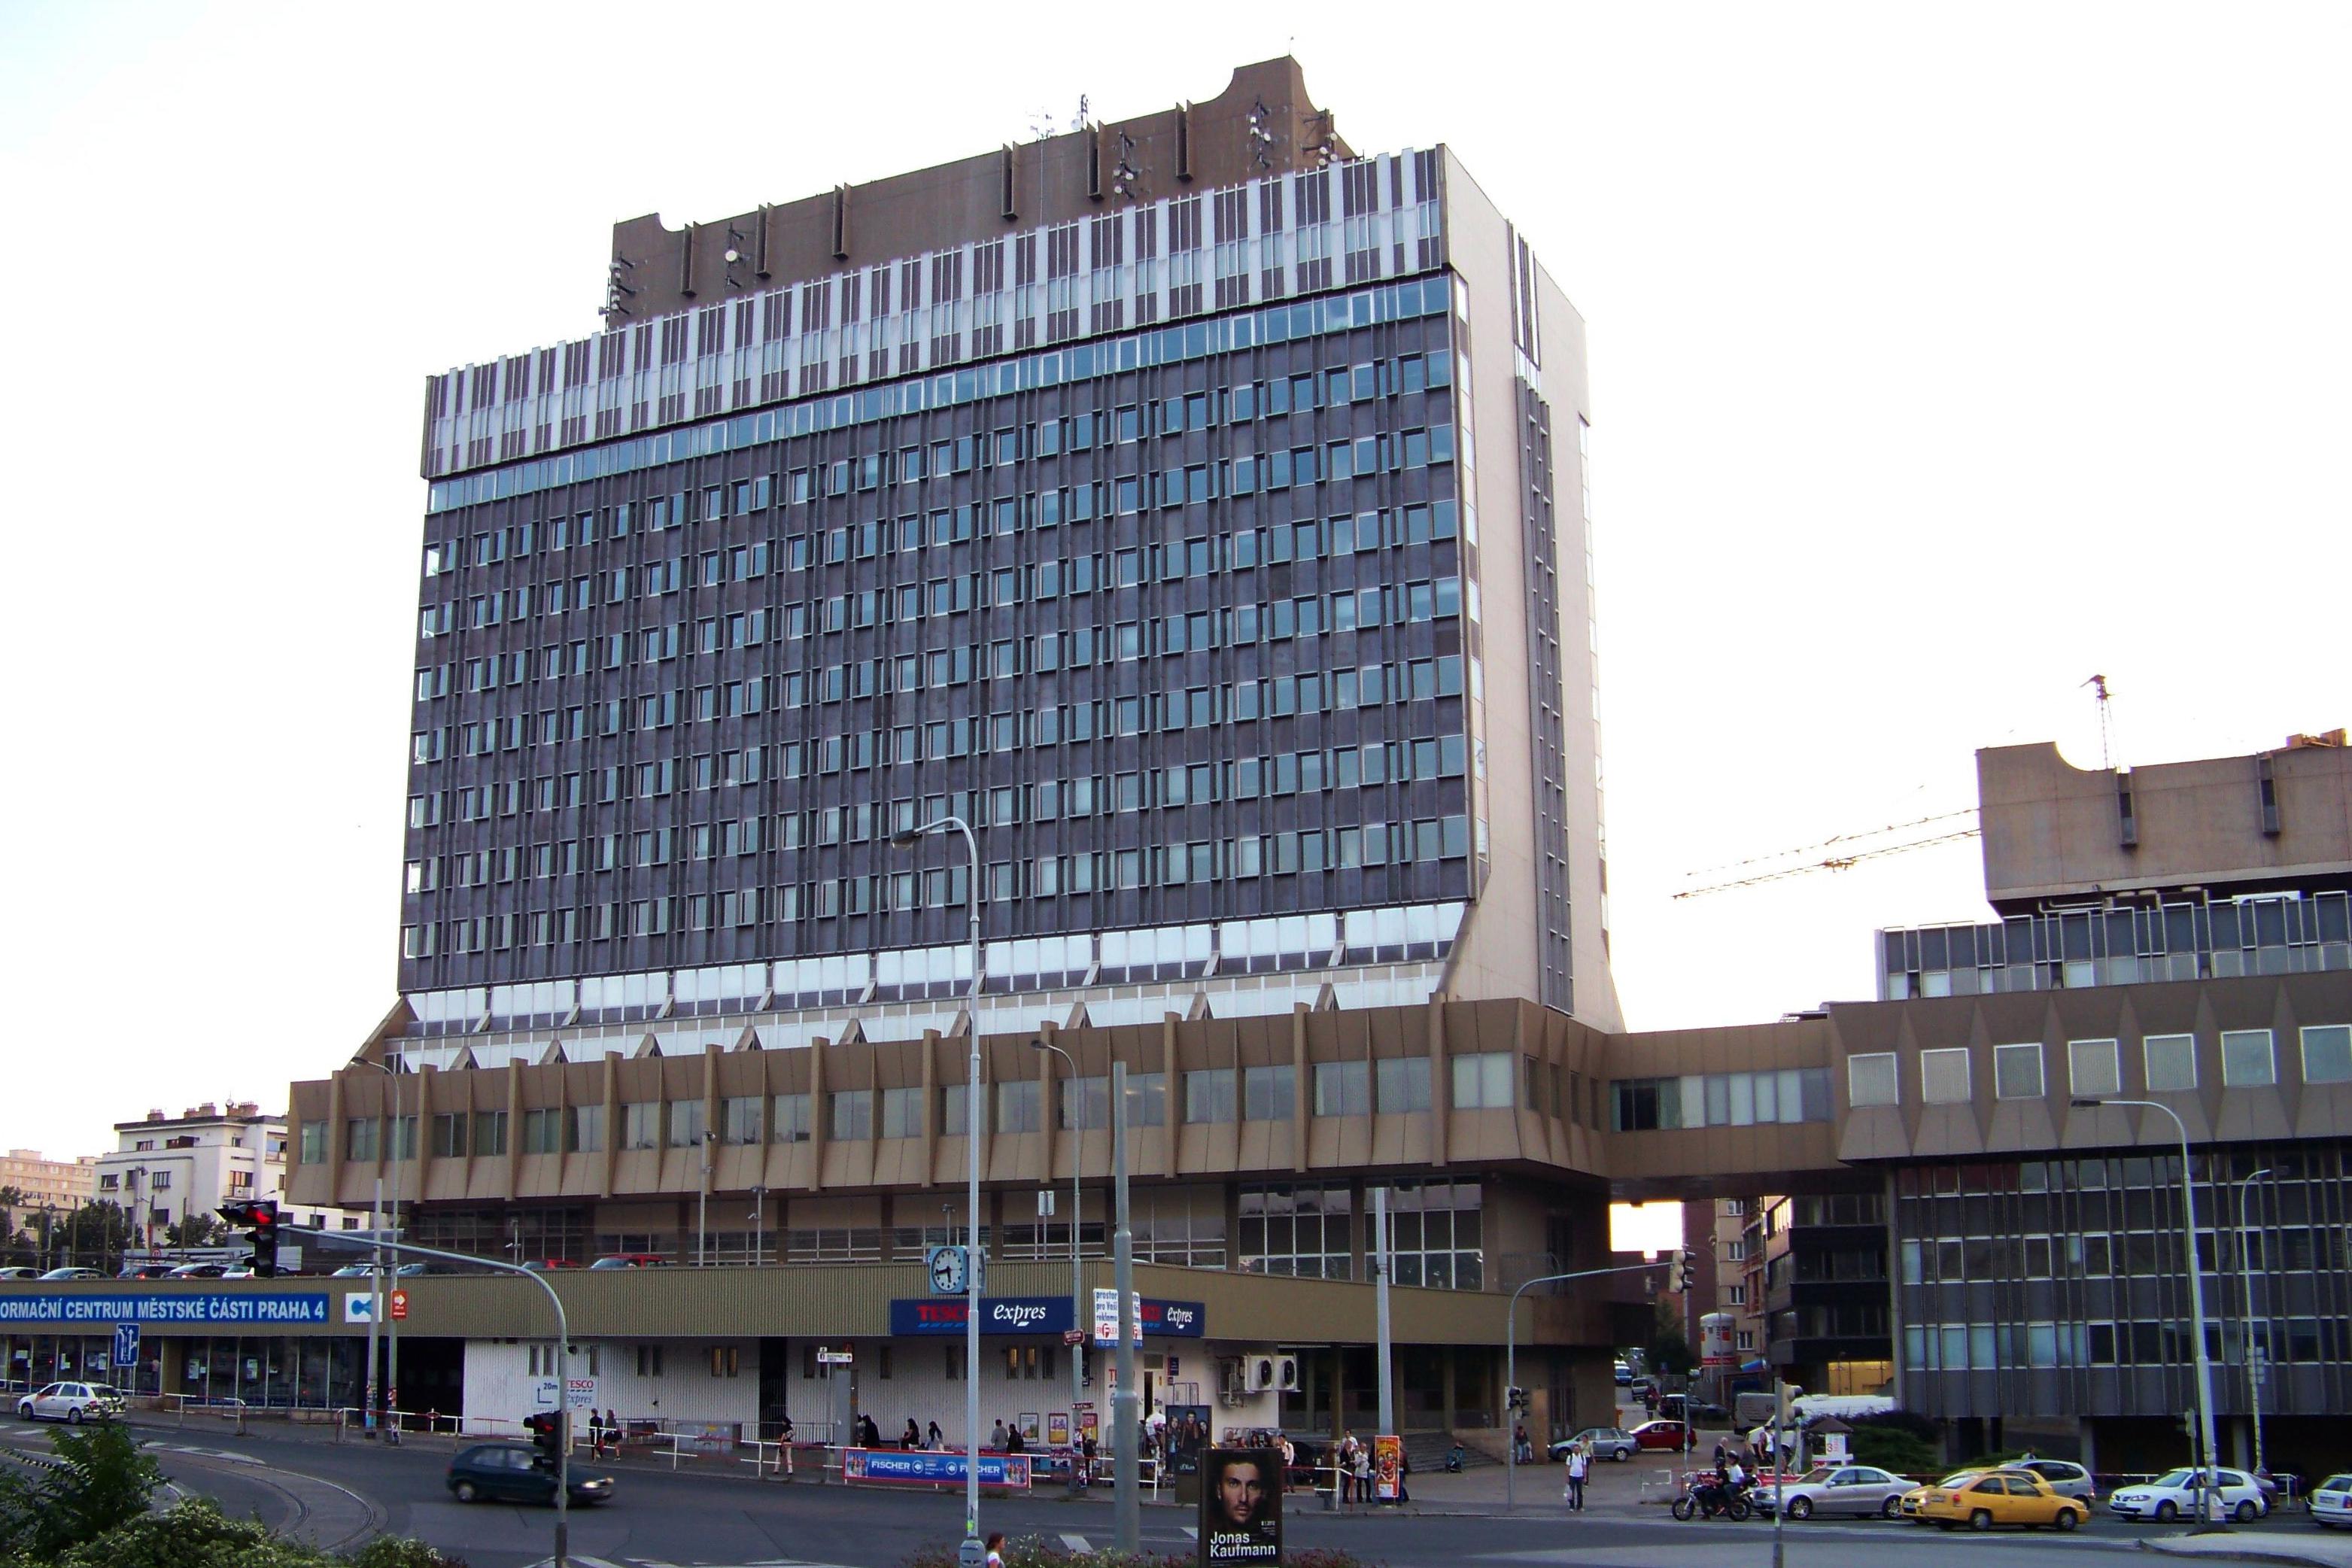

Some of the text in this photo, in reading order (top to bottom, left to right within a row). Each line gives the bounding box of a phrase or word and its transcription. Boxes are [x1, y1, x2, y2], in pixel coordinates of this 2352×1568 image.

[1096, 1291, 1117, 1302] prostor
[65, 1302, 133, 1318] CENTRUM
[138, 1298, 205, 1318] MĚSTSKÉ
[210, 1297, 253, 1319] ČÁSTI
[258, 1301, 310, 1319] PRAHA
[315, 1301, 324, 1319] 4
[994, 1304, 1046, 1324] expres
[1168, 1307, 1193, 1326] expres
[871, 1460, 910, 1470] FISCHER
[1210, 1531, 1250, 1544] Jonas
[1210, 1544, 1276, 1557] Kaufmann
